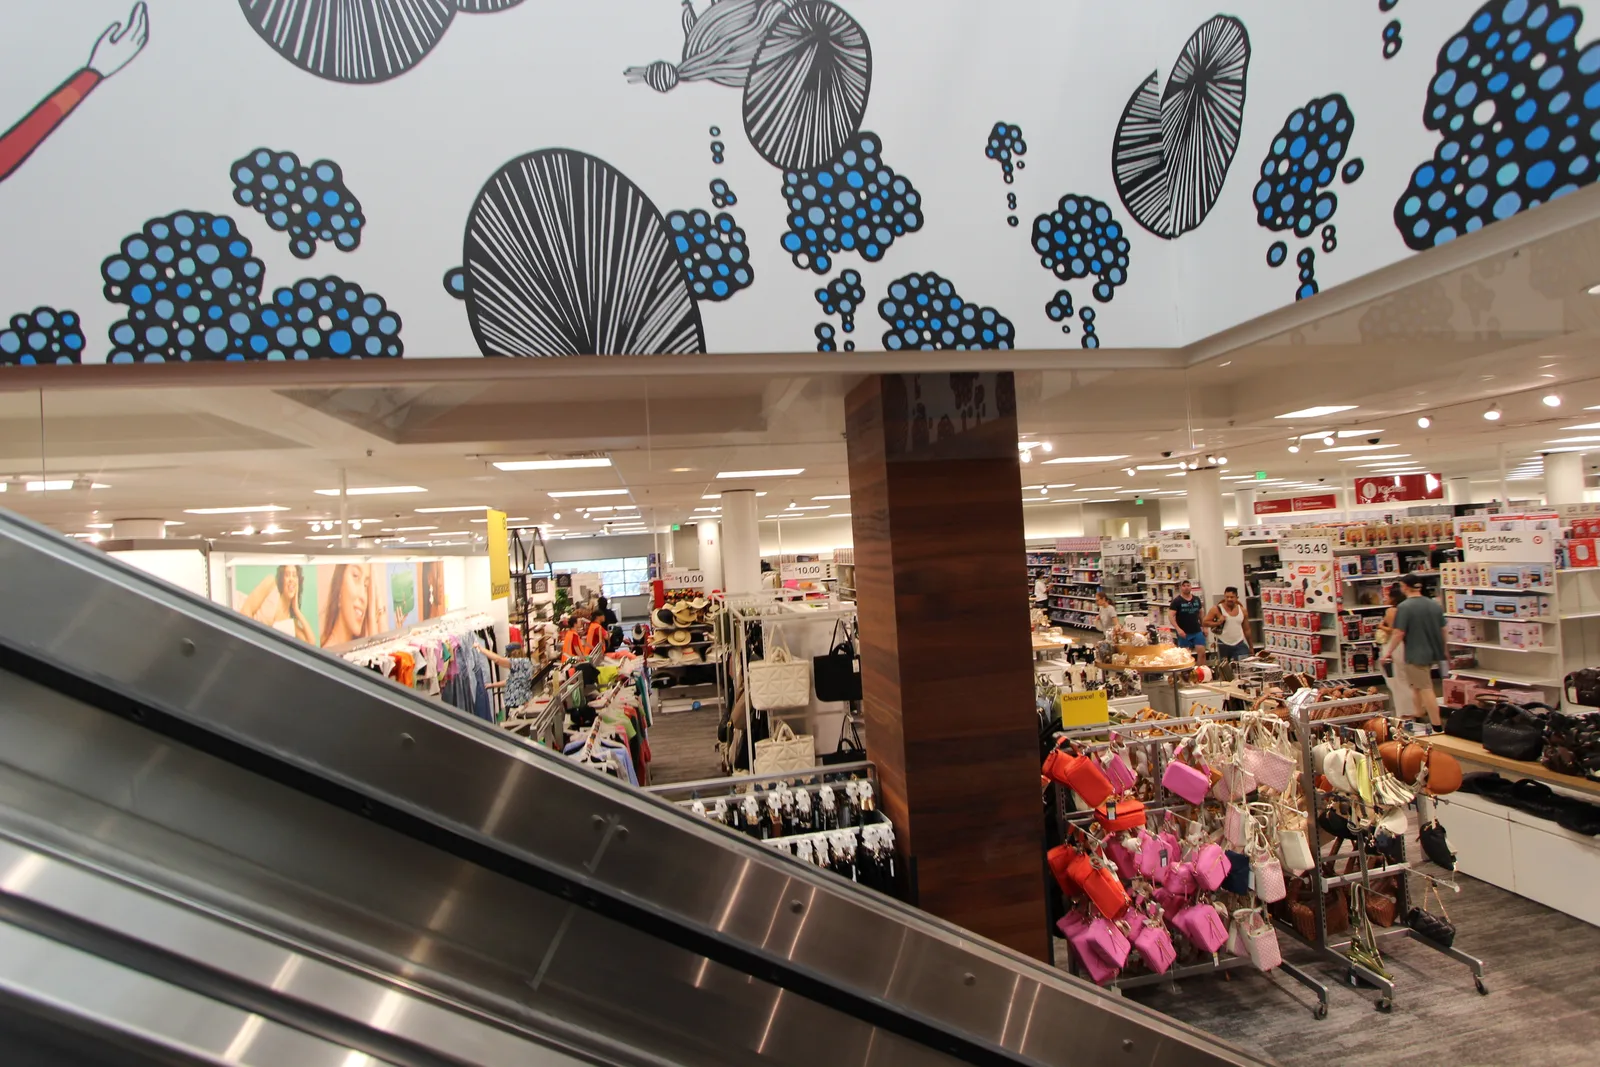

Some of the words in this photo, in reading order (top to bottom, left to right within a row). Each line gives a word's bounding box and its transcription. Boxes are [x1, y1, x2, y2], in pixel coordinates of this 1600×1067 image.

[1378, 485, 1407, 494] Kitchen
[1467, 536, 1496, 546] Expect
[1498, 536, 1522, 544] More.
[1117, 543, 1136, 551] $3.00
[1293, 543, 1328, 554] $35.49
[1485, 543, 1507, 551] Less.
[795, 566, 820, 574] $10.00
[675, 575, 704, 583] $10.00
[1127, 623, 1137, 631] $8
[1063, 692, 1095, 702] Clearance!
